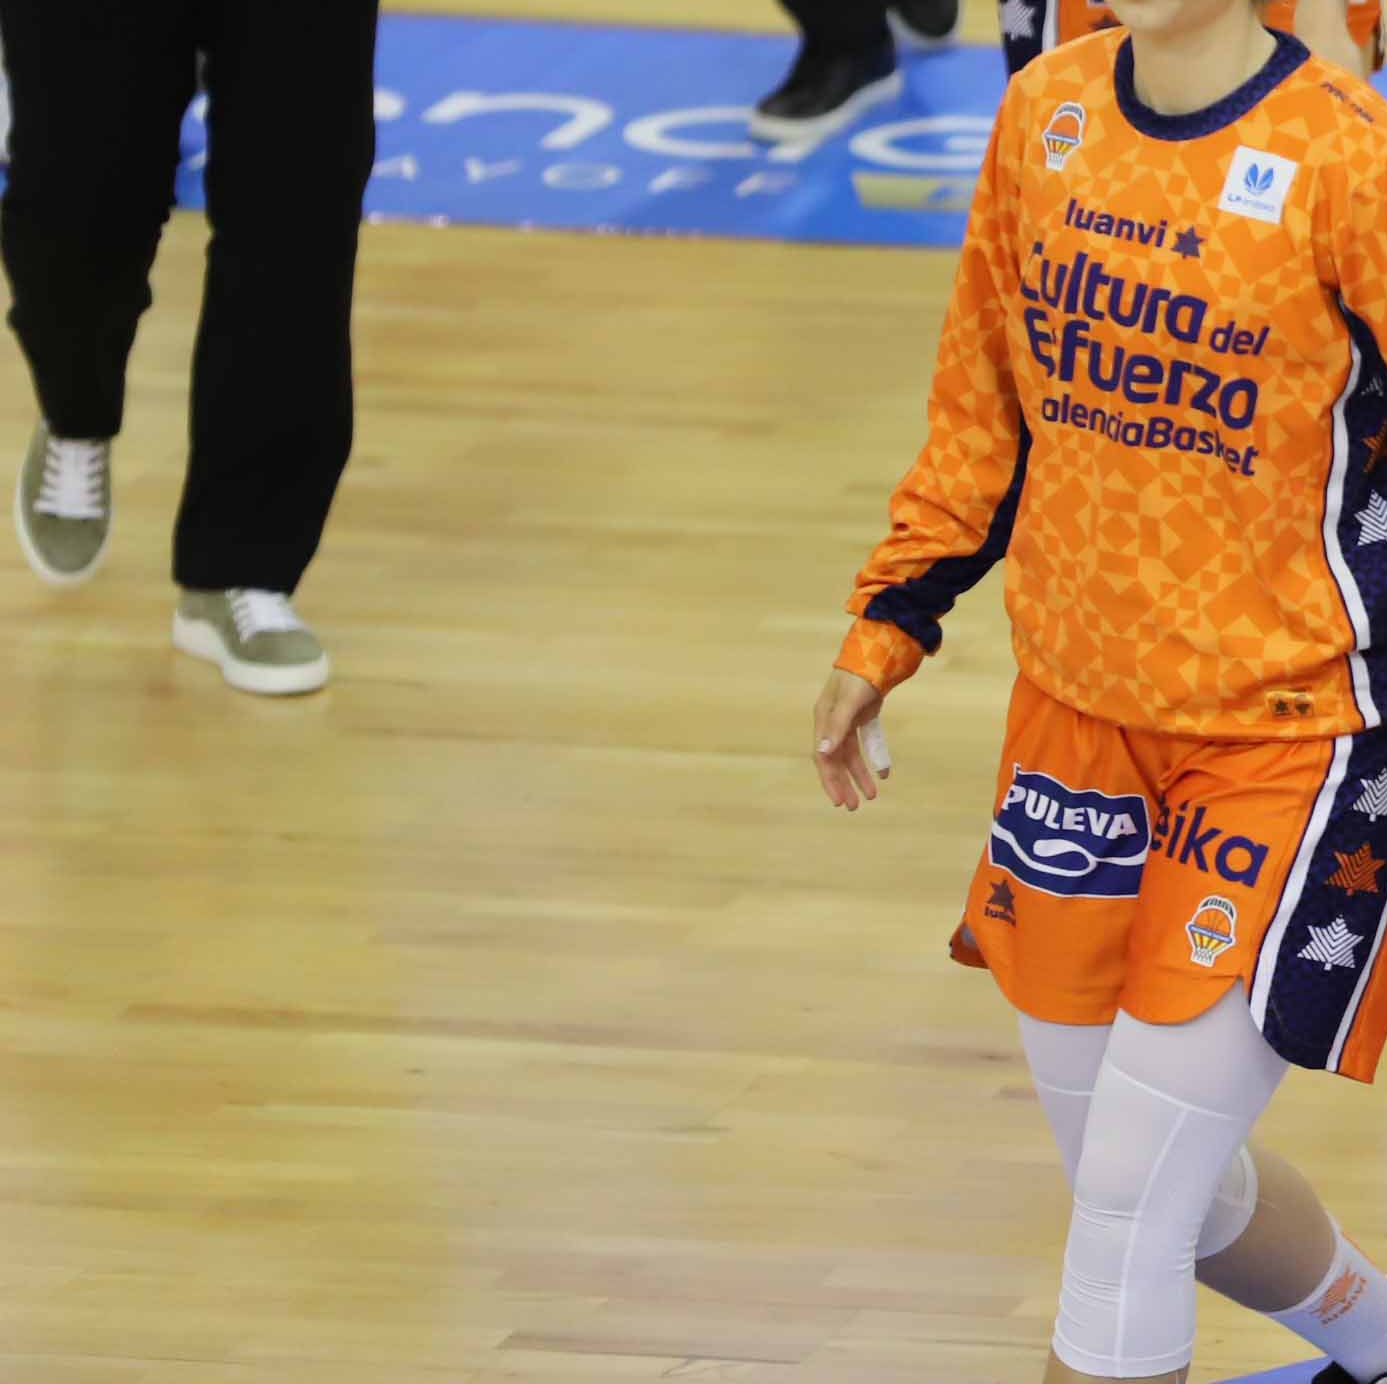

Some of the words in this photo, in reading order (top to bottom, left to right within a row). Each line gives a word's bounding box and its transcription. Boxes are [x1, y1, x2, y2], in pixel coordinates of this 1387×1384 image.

[1064, 198, 1167, 248] luanvi
[1210, 321, 1269, 356] del
[1002, 782, 1137, 842] PULEVA
